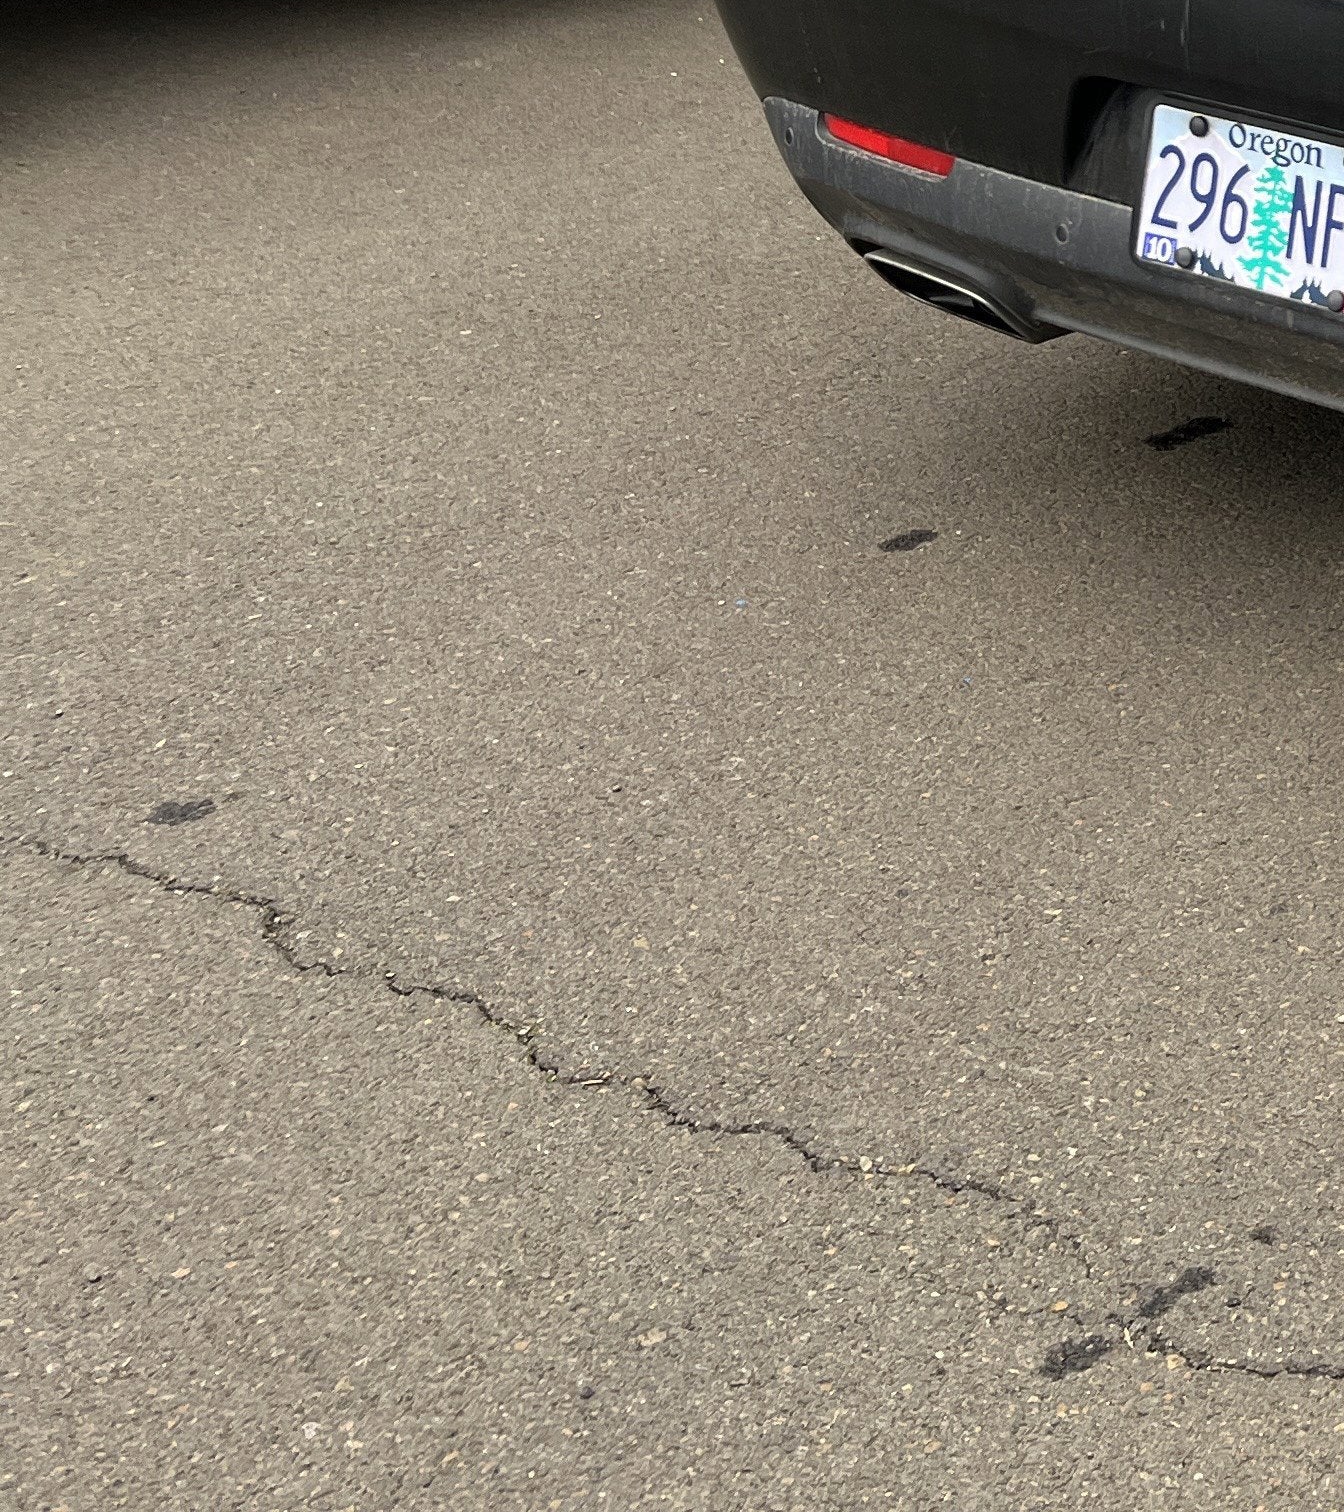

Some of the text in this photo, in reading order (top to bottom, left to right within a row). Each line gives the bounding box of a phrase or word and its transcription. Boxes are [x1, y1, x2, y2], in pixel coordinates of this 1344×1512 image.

[1228, 123, 1325, 169] Oregon
[1151, 144, 1251, 245] 296
[1146, 236, 1172, 262] 10
